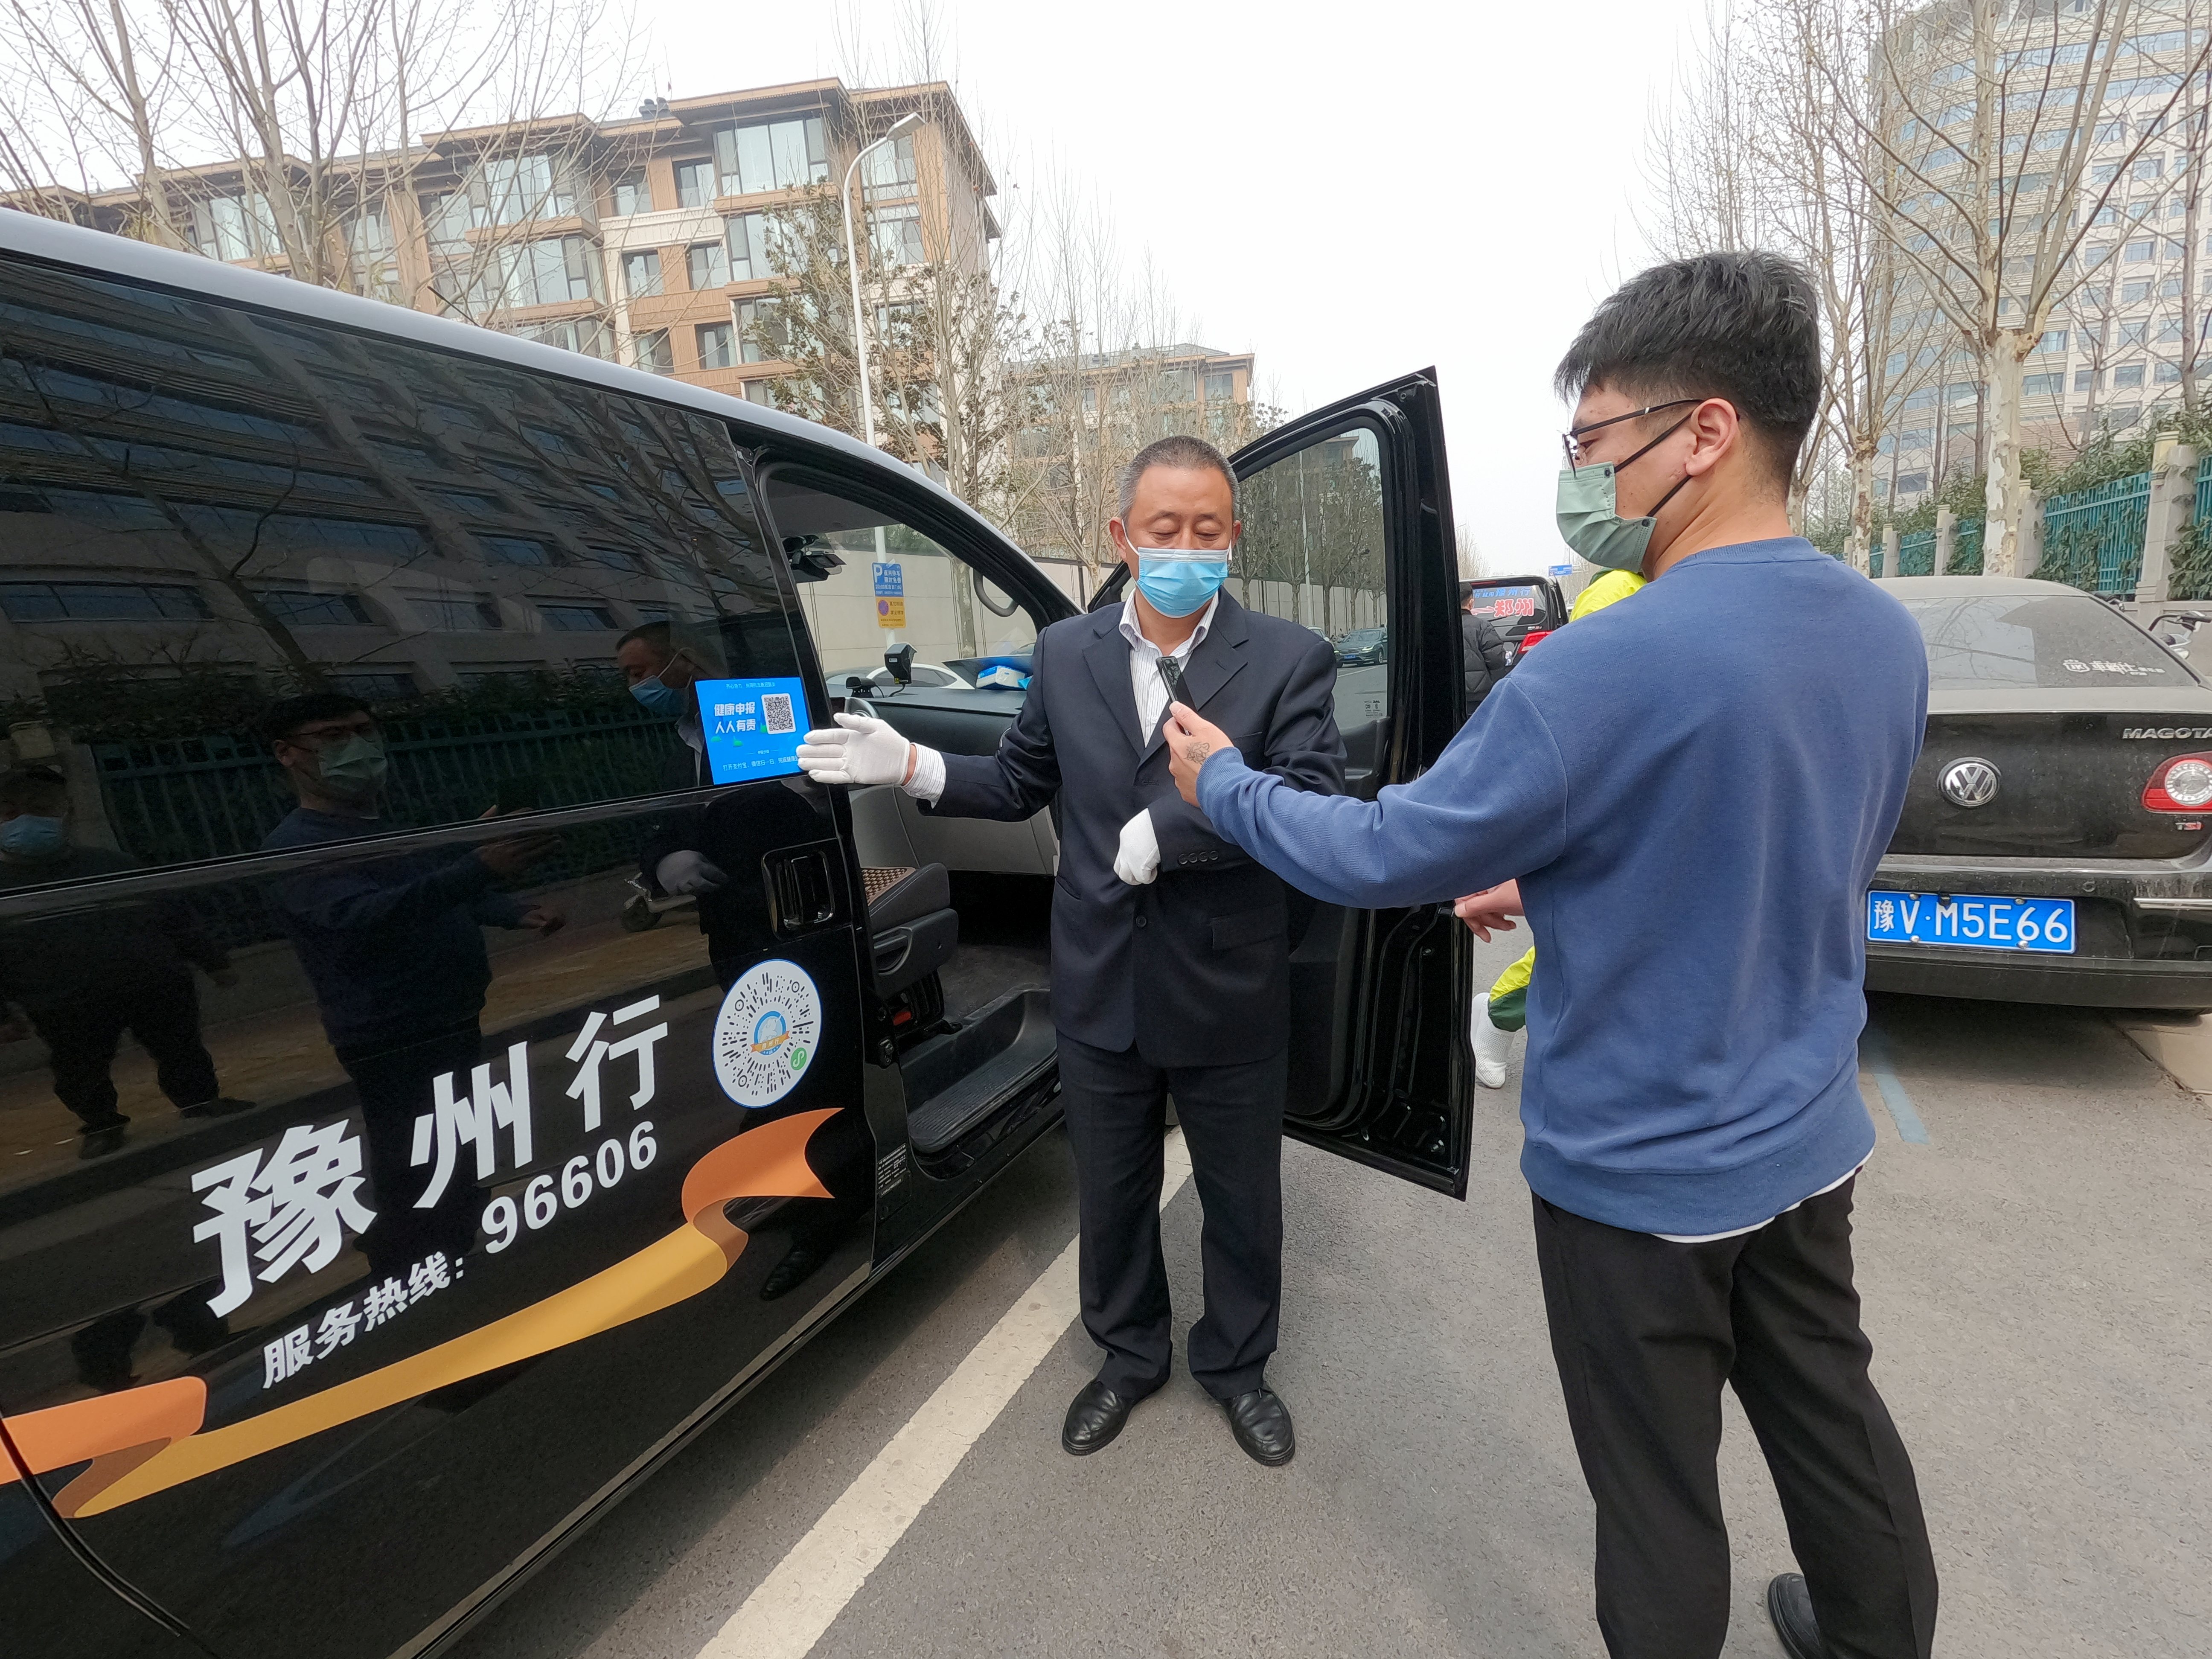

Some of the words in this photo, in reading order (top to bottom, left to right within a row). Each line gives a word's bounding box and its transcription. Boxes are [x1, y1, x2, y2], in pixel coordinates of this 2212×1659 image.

[873, 564, 882, 583] P
[1494, 598, 1534, 617] 郑州
[714, 701, 755, 716] 健康申报
[715, 719, 756, 734] 人人有责
[191, 994, 669, 1318] 豫州行
[481, 1121, 657, 1254] 96606
